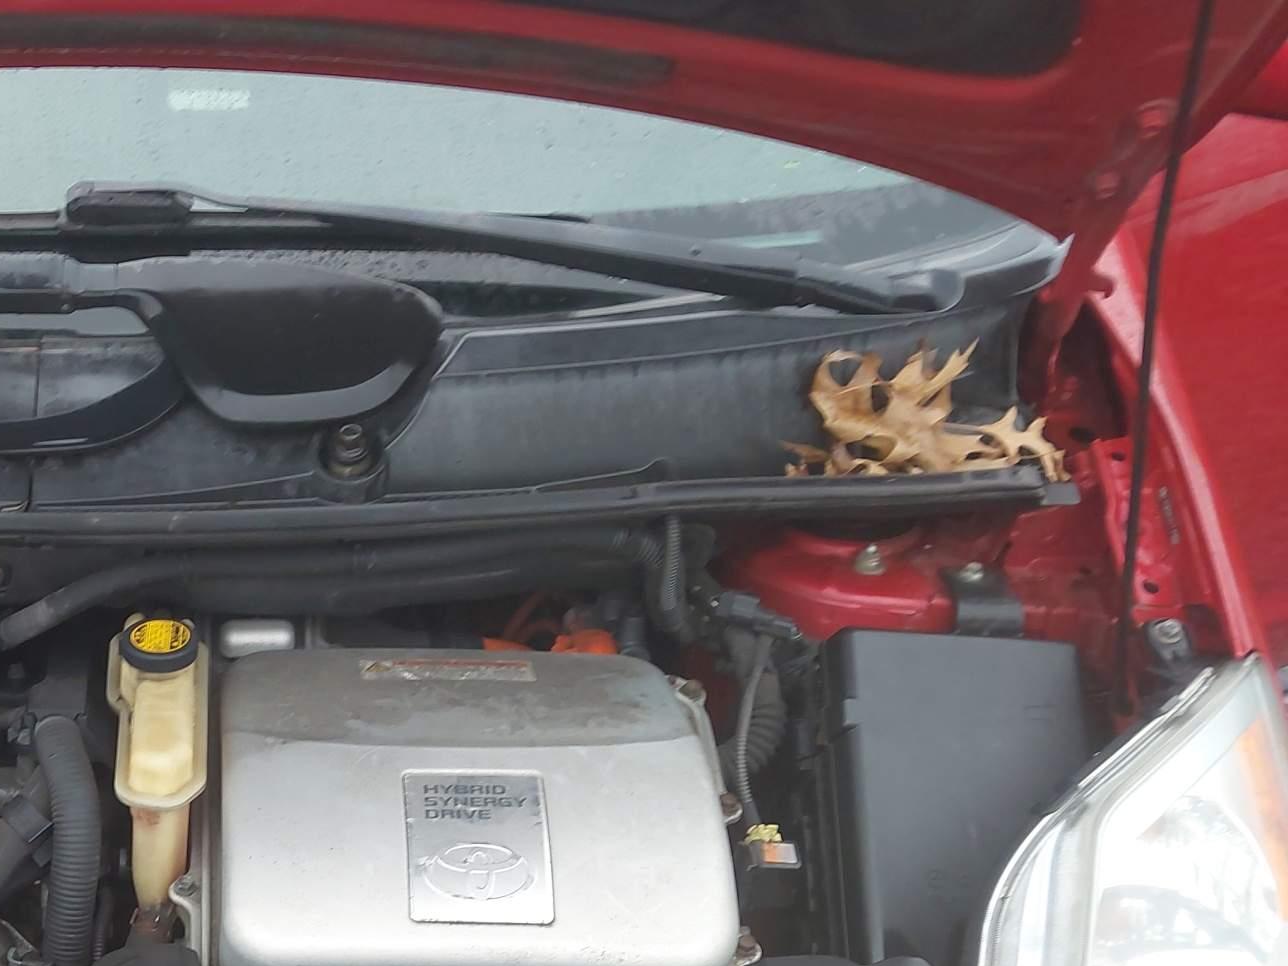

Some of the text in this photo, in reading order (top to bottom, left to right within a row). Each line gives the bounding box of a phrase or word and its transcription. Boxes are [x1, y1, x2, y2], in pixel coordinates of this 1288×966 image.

[423, 784, 506, 794] HYBRID
[423, 796, 527, 807] SYNERGY
[424, 809, 492, 819] DRIVE
